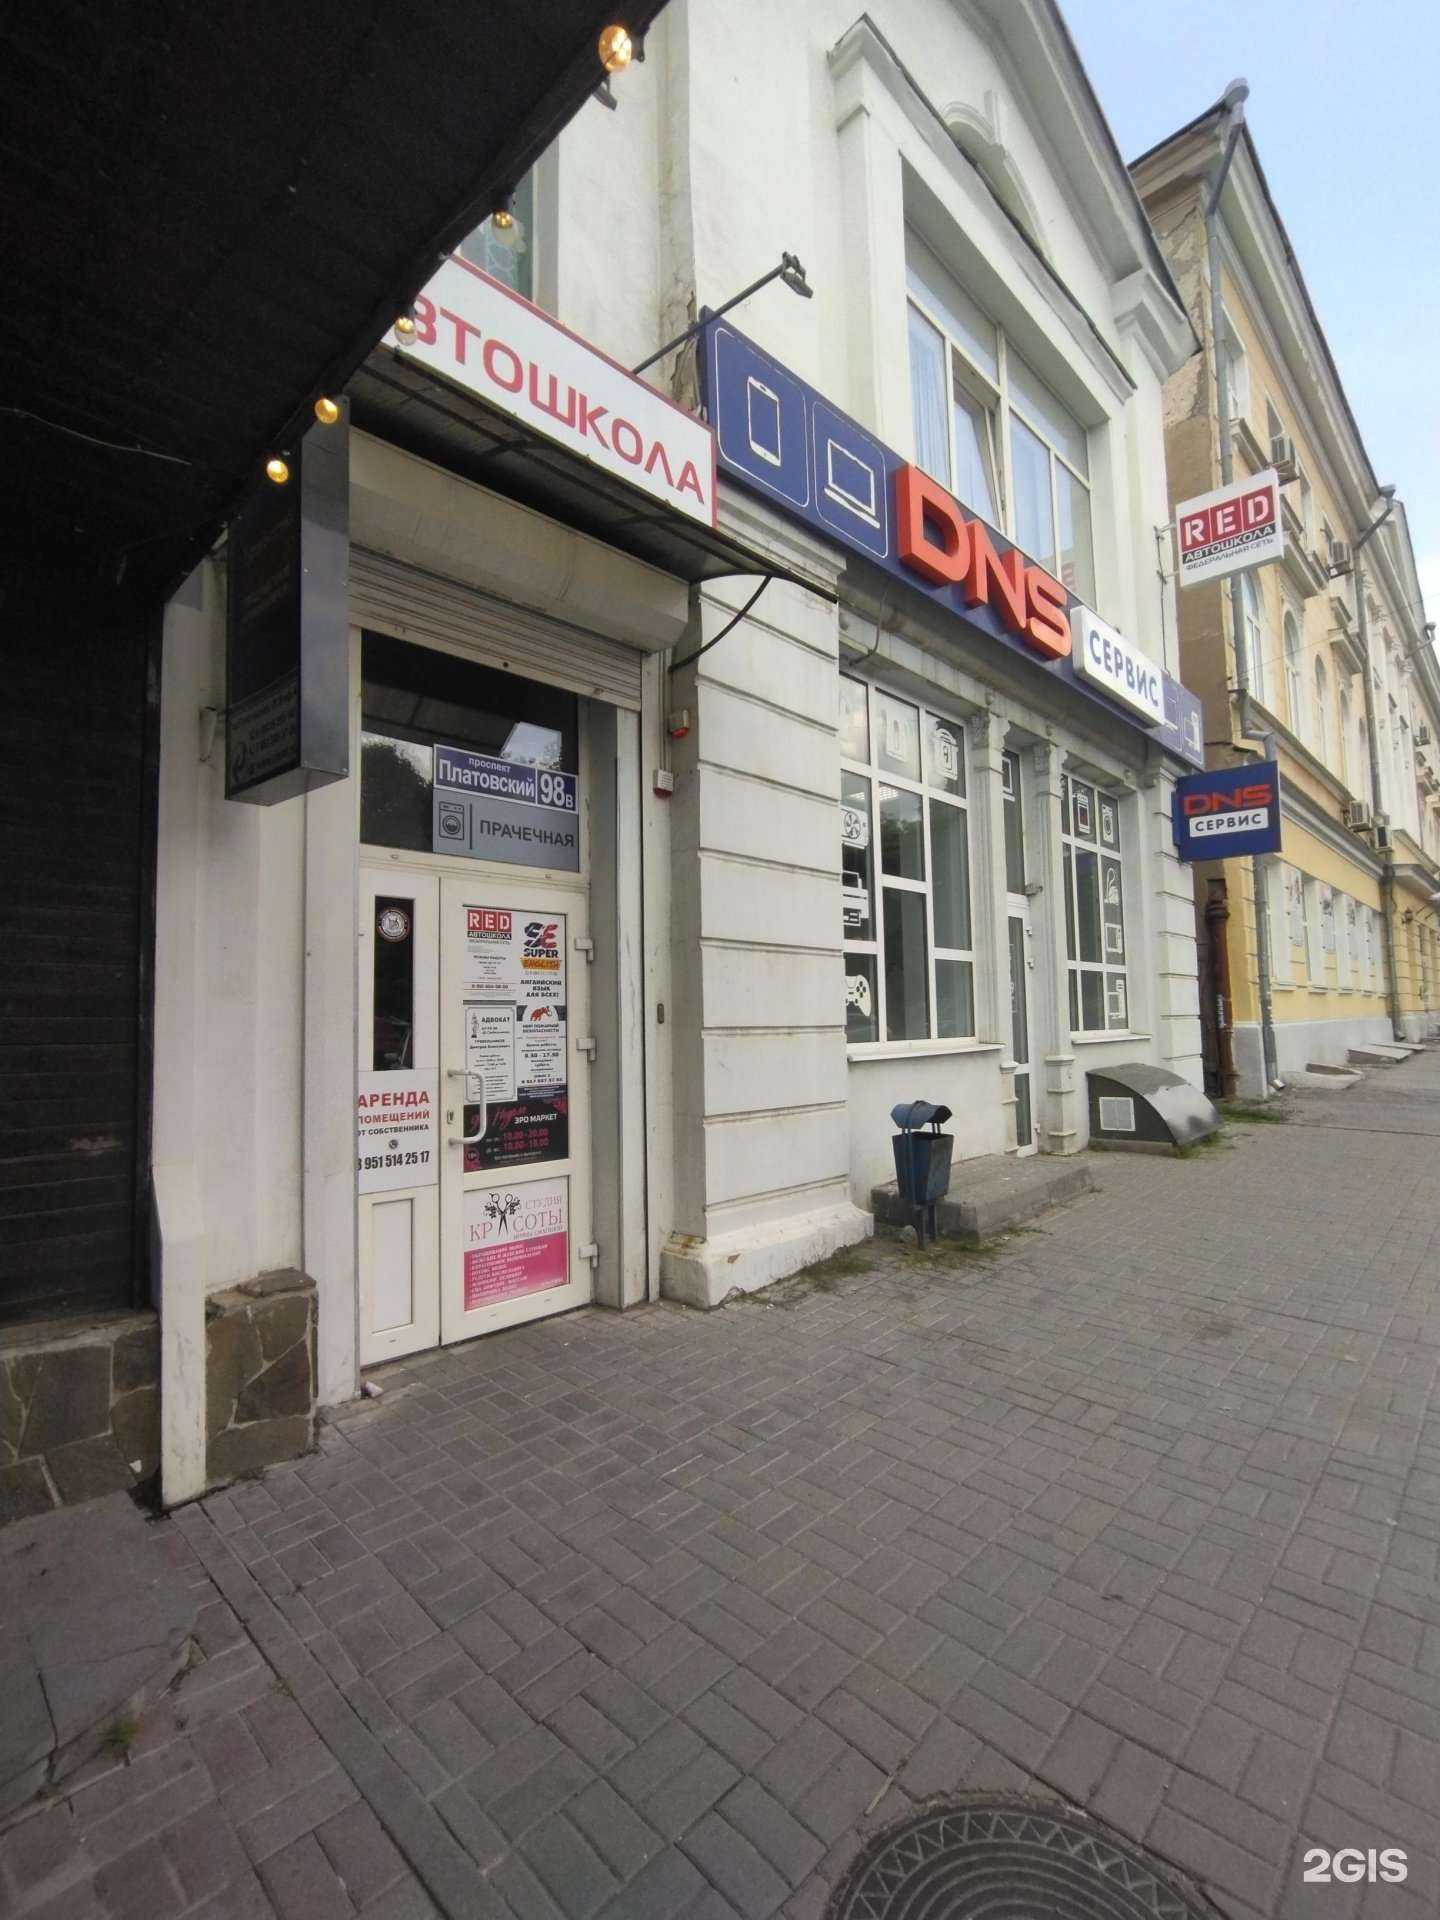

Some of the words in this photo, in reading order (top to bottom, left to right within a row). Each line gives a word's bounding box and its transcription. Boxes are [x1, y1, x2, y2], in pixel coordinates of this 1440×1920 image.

[1184, 495, 1269, 546] RED
[1185, 526, 1273, 562] АВТОШКОЛА
[896, 463, 1072, 661] DNS
[1089, 629, 1160, 708] СЕРВИС
[468, 757, 511, 773] проспект
[438, 758, 535, 798] Платовский
[1183, 783, 1273, 816] DNS
[1195, 813, 1262, 832] СЕРВИС
[479, 819, 575, 848] ПРАЧЕЧНАЯ
[469, 912, 511, 930] RED
[468, 931, 512, 940] АВТОШКОЛА
[523, 948, 559, 958] SUPER
[357, 1090, 431, 1108] АРЕНДА
[514, 1116, 529, 1124] ЭРО
[529, 1113, 558, 1122] МАРКЕТ
[368, 1124, 430, 1136] СОБСТВЕННИКА
[364, 1156, 384, 1170] 951
[385, 1153, 403, 1168] 514
[405, 1152, 418, 1165] 25
[420, 1150, 430, 1163] 17
